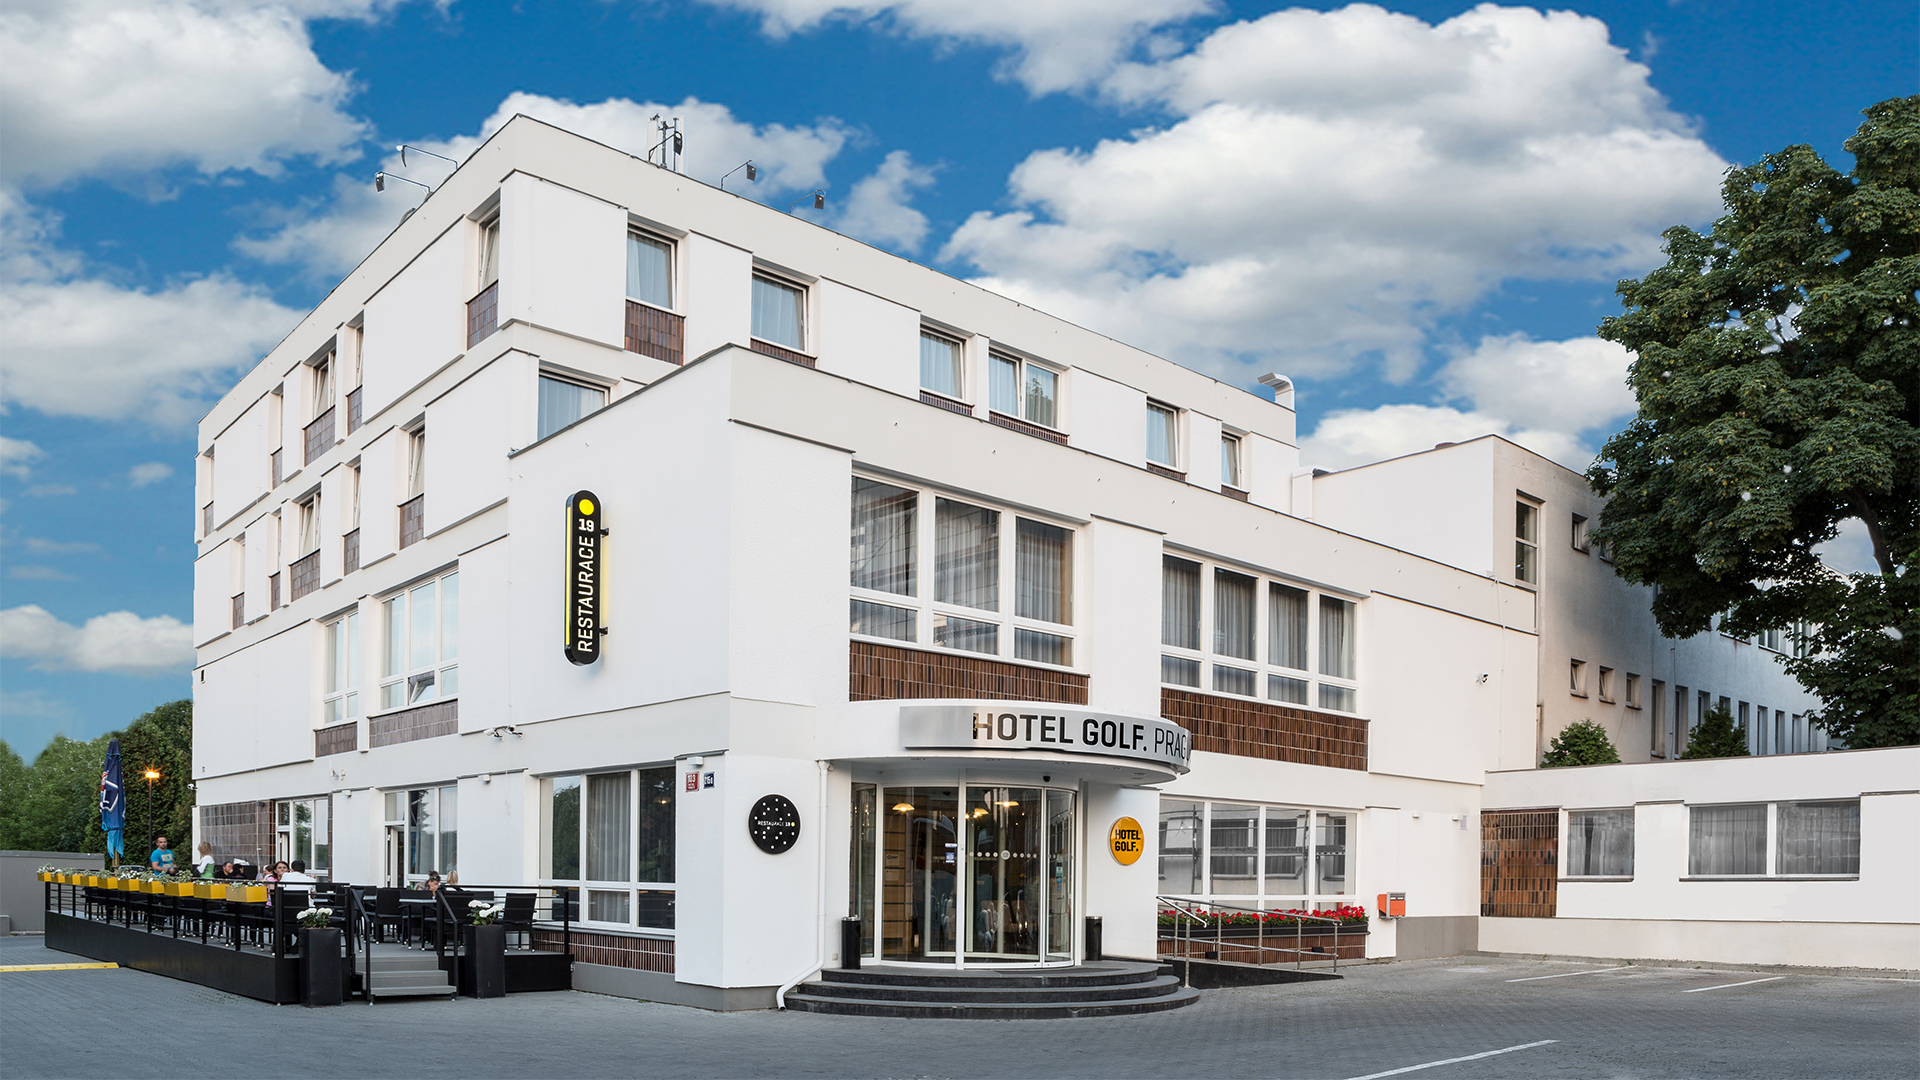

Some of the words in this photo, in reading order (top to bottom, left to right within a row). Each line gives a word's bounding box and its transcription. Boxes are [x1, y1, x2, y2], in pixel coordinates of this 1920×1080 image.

[578, 518, 595, 533] 19
[577, 534, 594, 653] RESTAURACE
[973, 712, 1074, 744] HOTEL
[1082, 718, 1147, 752] GOLF.
[1115, 829, 1141, 840] HOTEL
[1115, 841, 1139, 852] GOLF.
